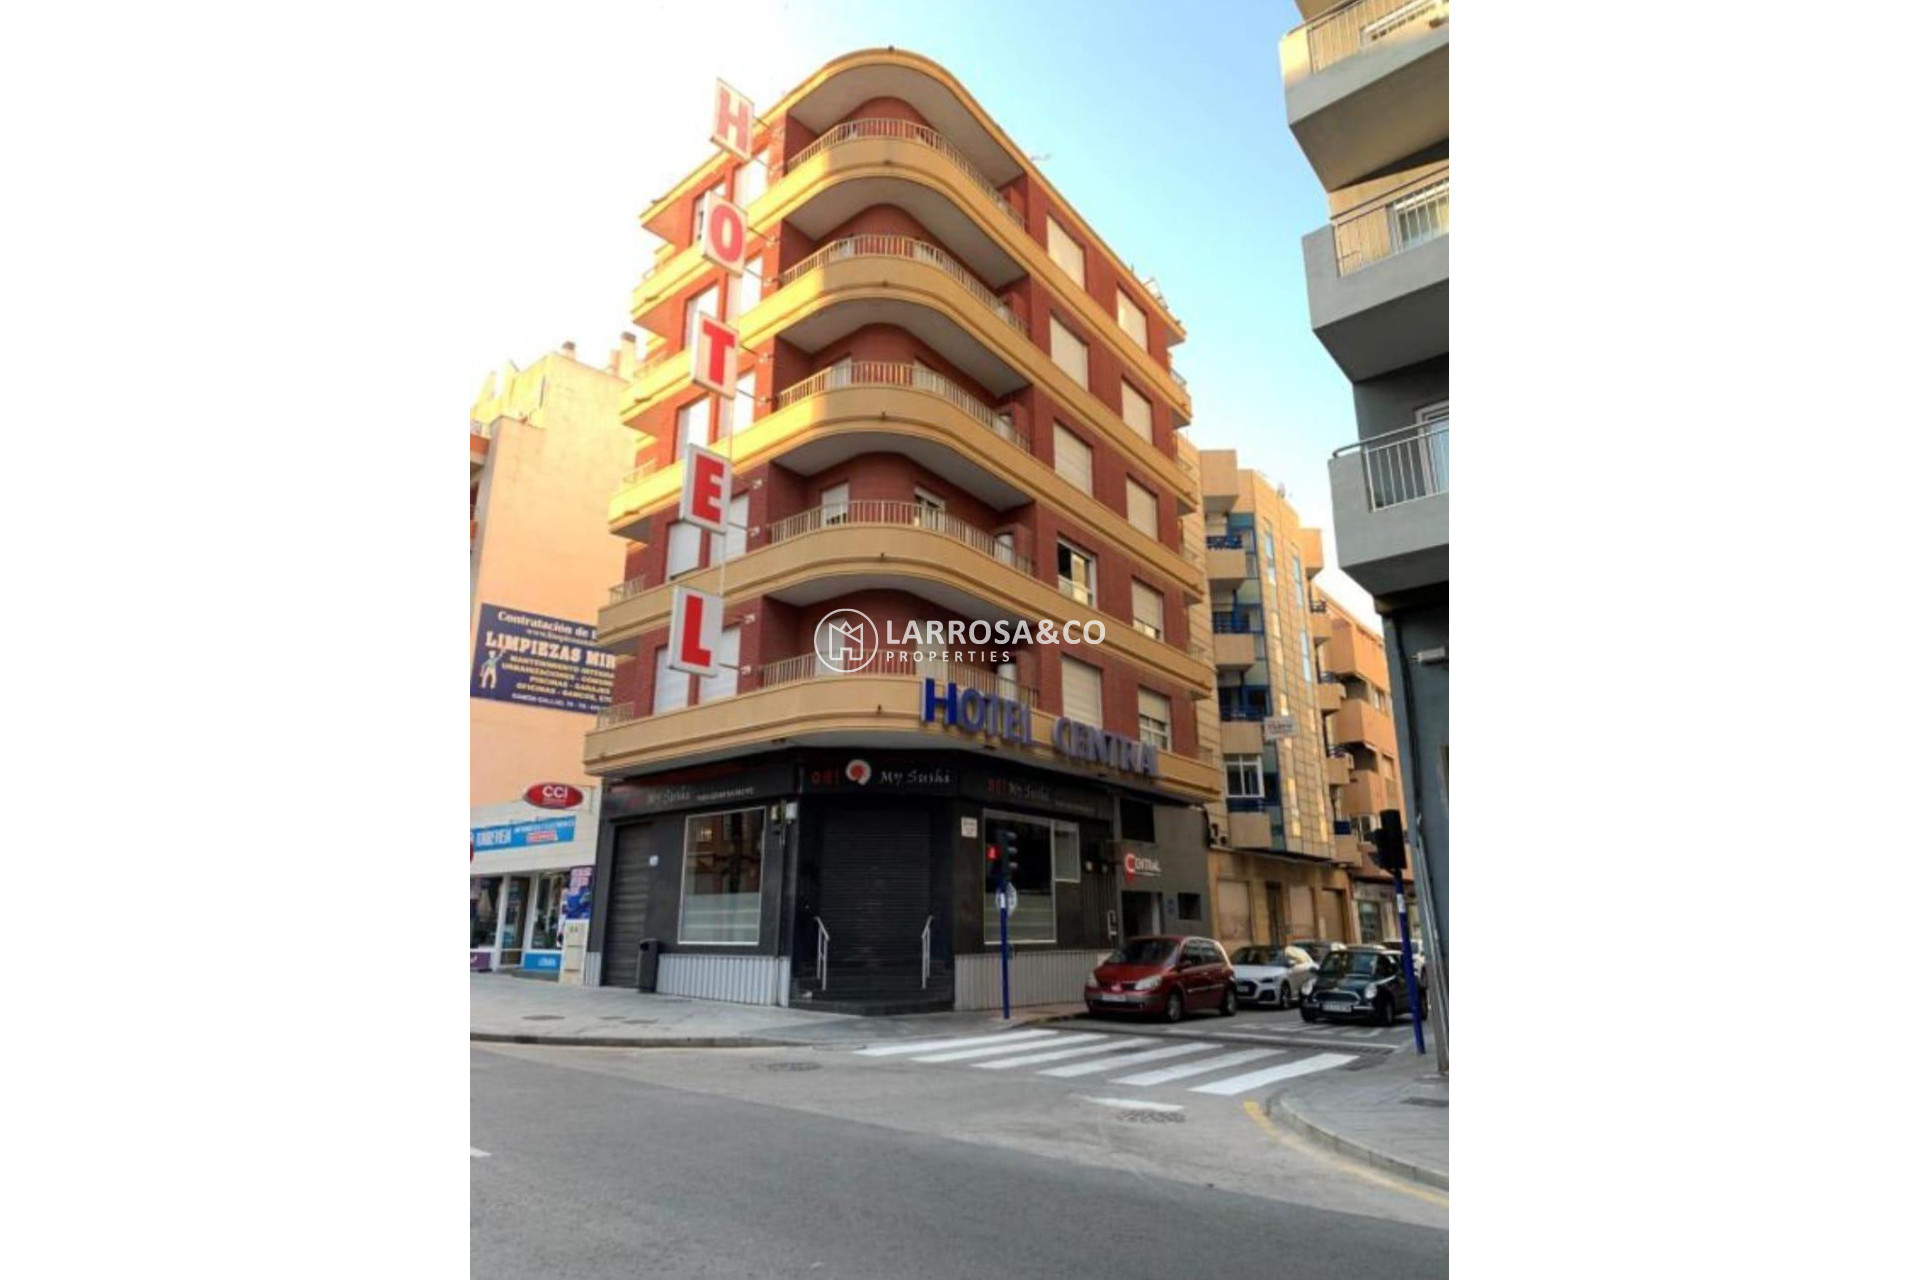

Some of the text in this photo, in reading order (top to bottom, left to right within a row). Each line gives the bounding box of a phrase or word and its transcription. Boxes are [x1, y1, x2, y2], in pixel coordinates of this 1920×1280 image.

[681, 86, 749, 668] HOTEL
[498, 611, 572, 635] Contratación
[575, 626, 588, 638] de
[485, 630, 581, 663] LIMPIEZAS
[921, 677, 1032, 745] HOTEL
[907, 769, 950, 784] Sushi
[542, 785, 568, 799] CCI
